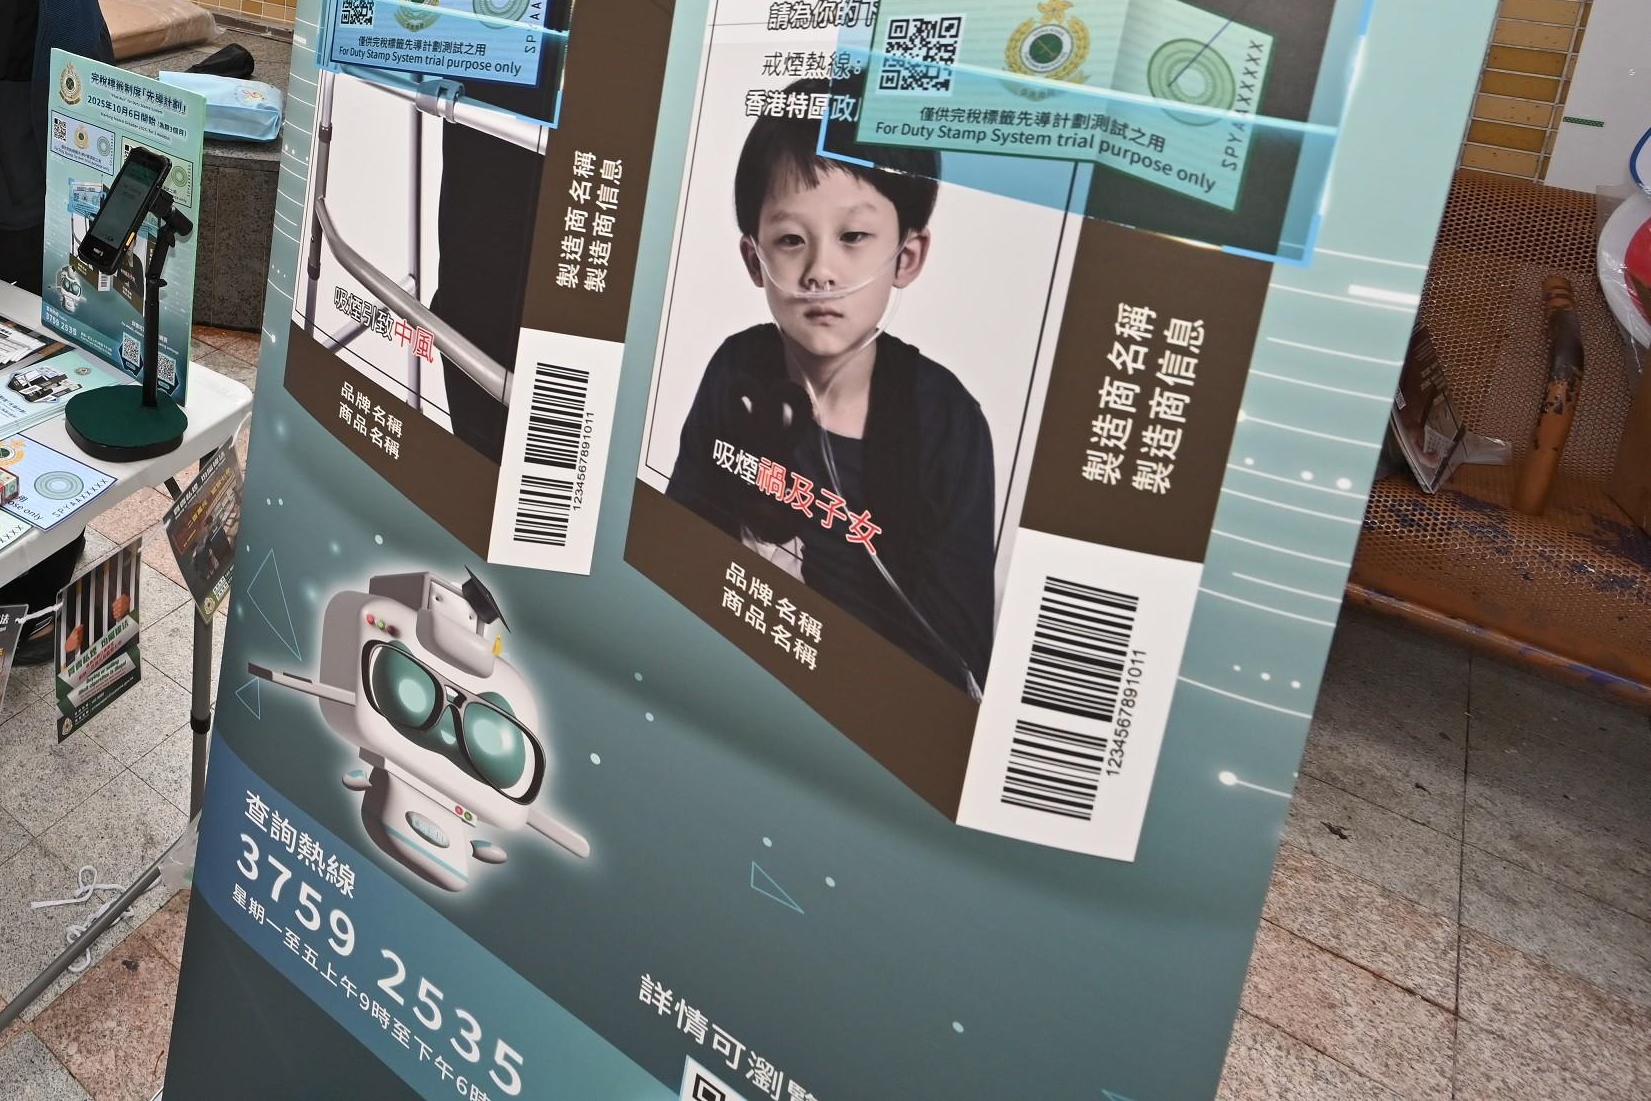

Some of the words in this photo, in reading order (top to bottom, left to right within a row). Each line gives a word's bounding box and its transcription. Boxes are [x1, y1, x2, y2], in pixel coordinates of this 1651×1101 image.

[339, 46, 349, 57] For
[349, 46, 366, 62] Duty
[366, 49, 391, 64] Stamp
[391, 50, 423, 66] System
[425, 52, 445, 67] trial
[446, 56, 492, 73] purpose
[494, 59, 522, 77] only
[358, 35, 486, 57] 僅供完稅標籤先導計劃測試之用
[87, 95, 156, 127] 2025年10月6日開始
[745, 89, 862, 122] 香港特區政
[919, 106, 1166, 153] 僅供完稅標籤先導計劃測試之用
[875, 121, 897, 136] For
[900, 121, 935, 142] Duty
[937, 123, 987, 144] Stamp
[990, 126, 1052, 148] System
[1056, 129, 1094, 150] trial
[1098, 131, 1171, 176] purpose
[1176, 169, 1216, 194] only
[555, 151, 596, 289] 製造商名稱
[583, 159, 623, 292] 製造商信息
[45, 312, 60, 326] 3759
[60, 321, 77, 336] 2535
[333, 285, 436, 363] 吸煙引致中風
[338, 402, 400, 460] 商品名稱
[340, 381, 403, 438] 品牌名稱
[1082, 302, 1157, 486] 製造商名稱
[1132, 318, 1206, 495] 製造商信息
[572, 411, 595, 512] 1234567891011
[712, 438, 883, 555] 吸煙禍及子女
[24, 507, 44, 521] only
[721, 586, 818, 671] 商品名稱
[724, 561, 823, 643] 品牌名稱
[1105, 648, 1147, 778] 1234567891011
[244, 790, 356, 899] 查詢熱線
[236, 833, 356, 957] 3759
[376, 948, 524, 1096] 2535
